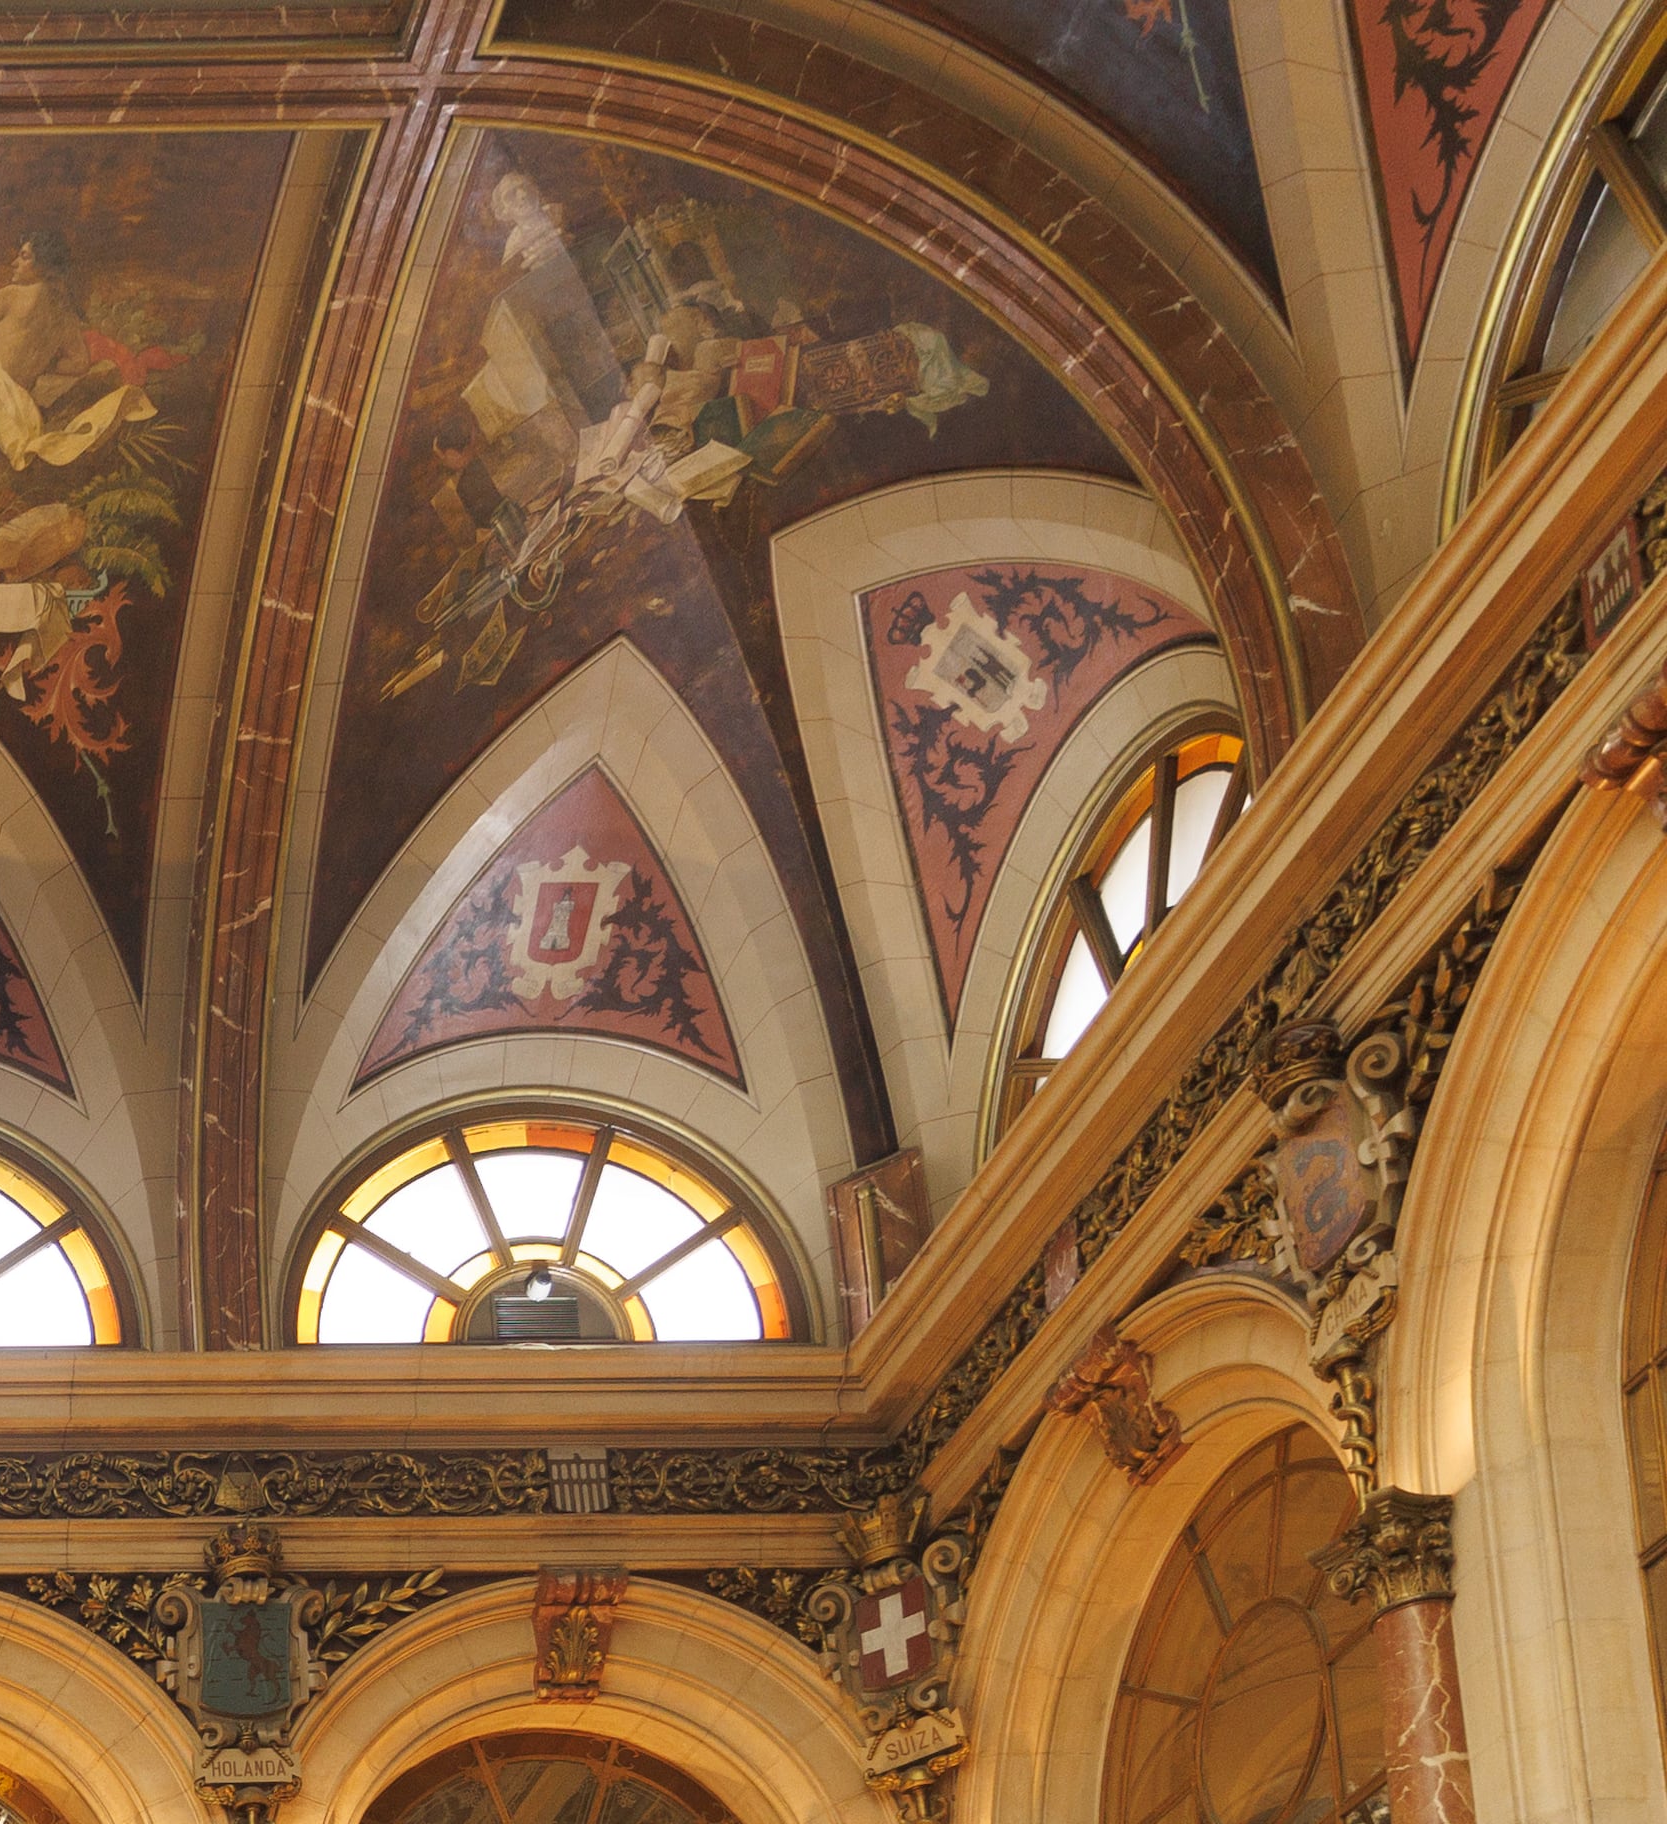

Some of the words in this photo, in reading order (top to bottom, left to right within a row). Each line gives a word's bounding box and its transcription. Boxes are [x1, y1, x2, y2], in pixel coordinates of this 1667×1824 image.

[1326, 1281, 1367, 1336] CHINA
[885, 1726, 943, 1761] SUIZA
[211, 1760, 286, 1777] HOLANDA
